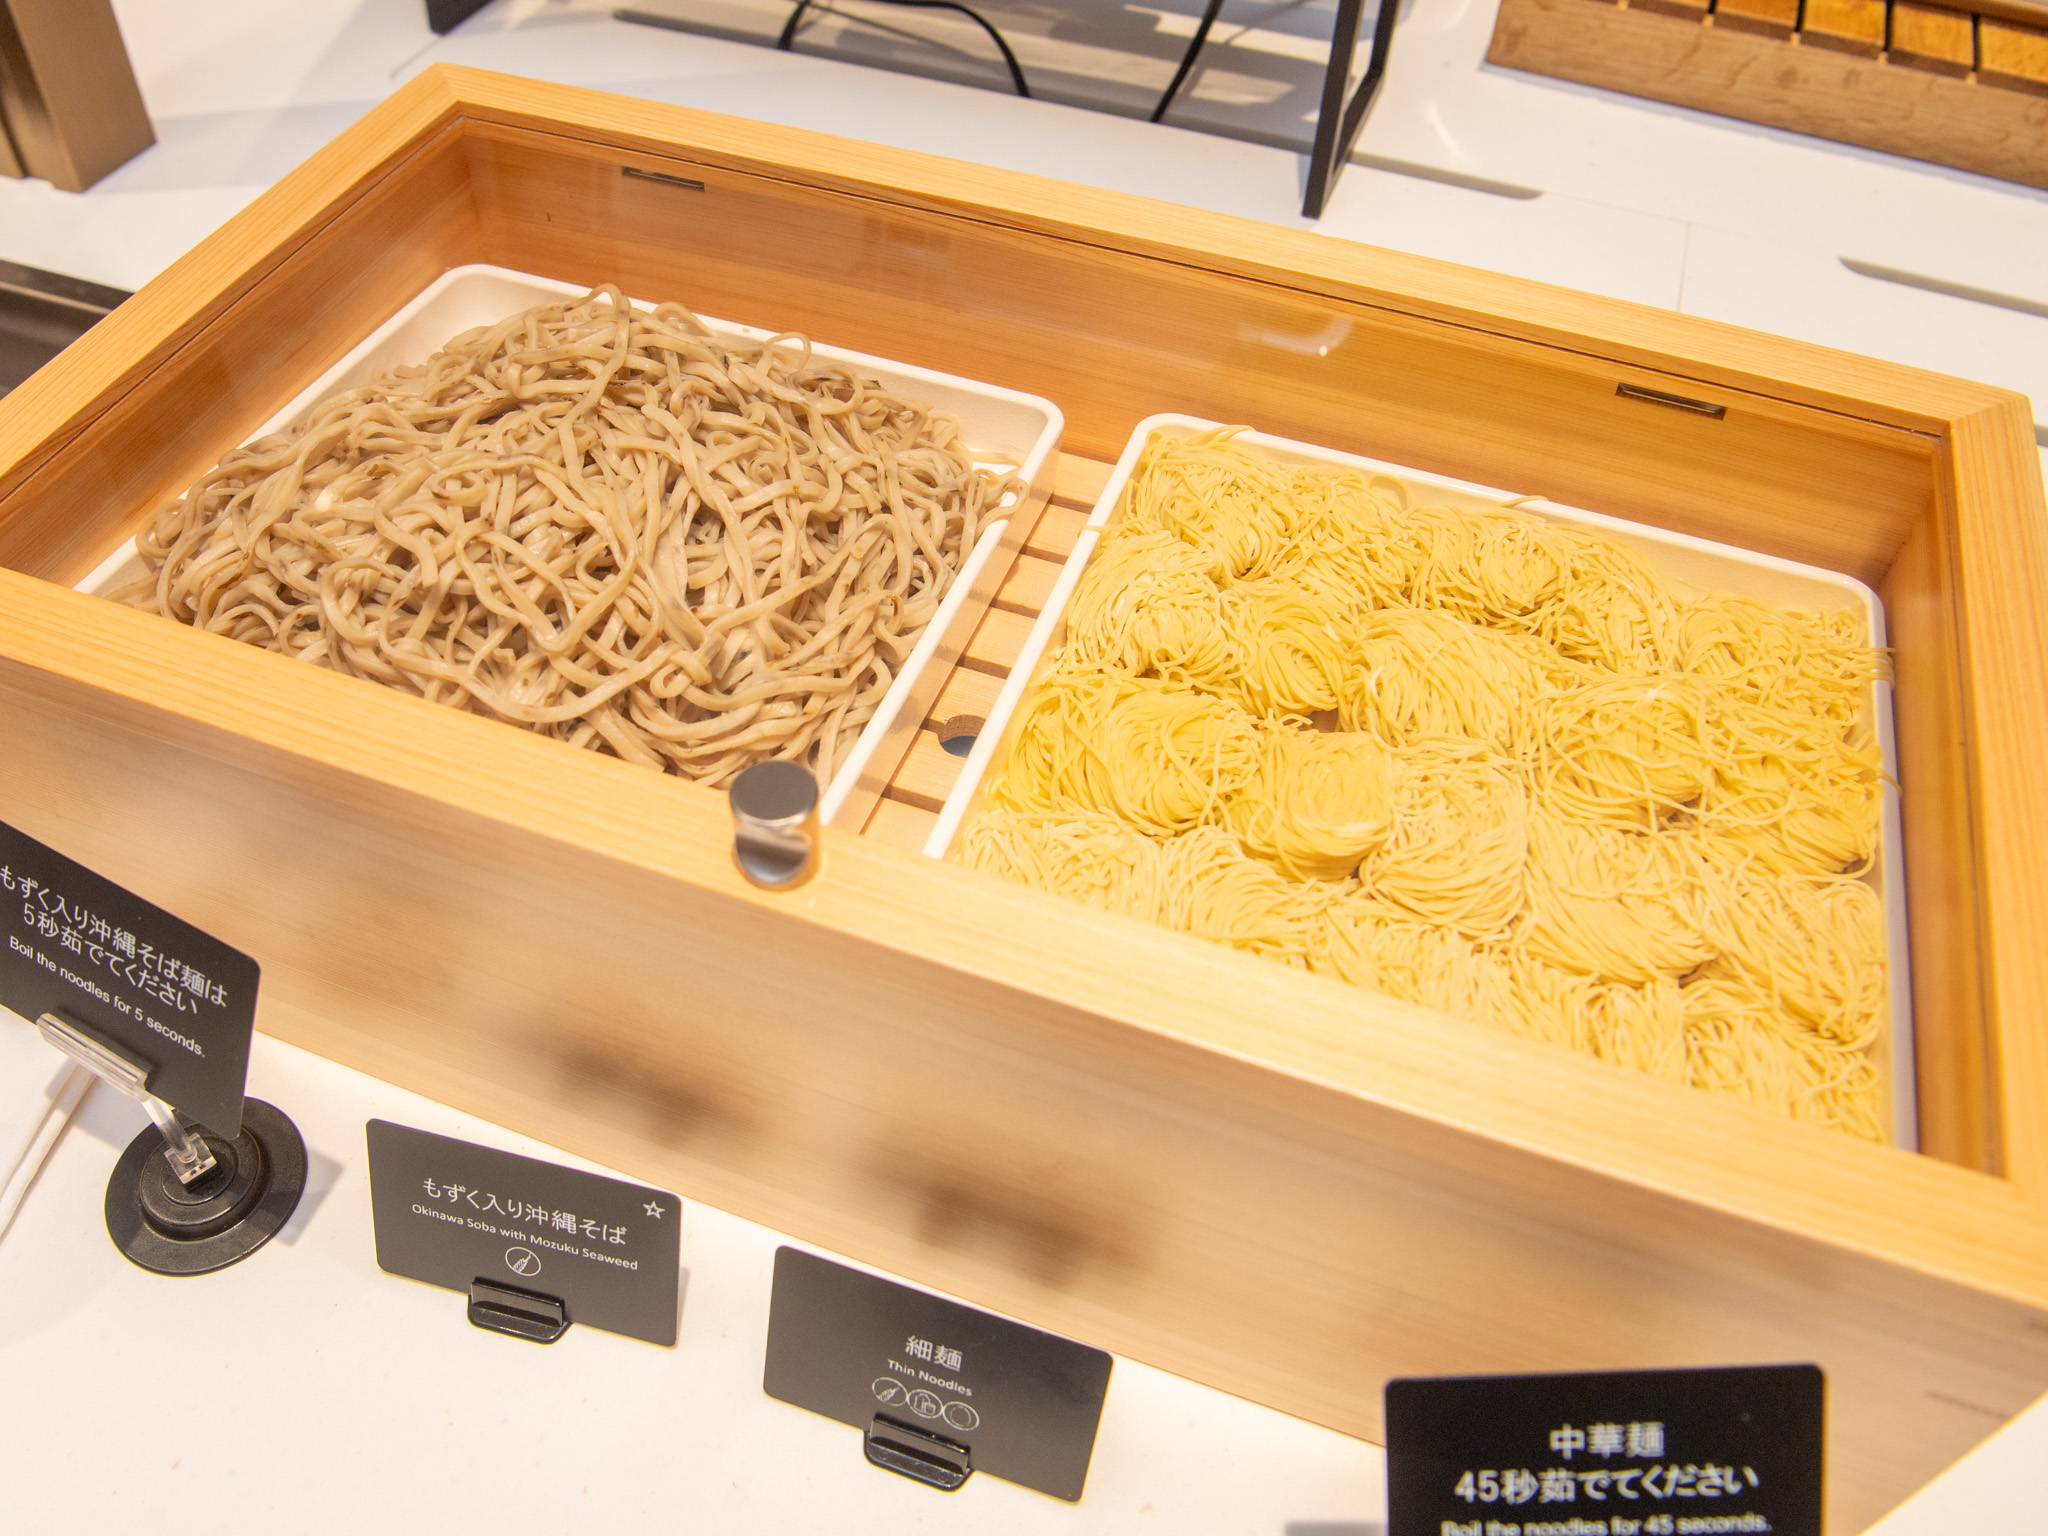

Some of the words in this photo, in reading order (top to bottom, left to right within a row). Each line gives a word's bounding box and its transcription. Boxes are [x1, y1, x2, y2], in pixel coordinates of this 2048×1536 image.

[0, 865, 228, 1008] もずく入り沖縄そば麺は
[23, 903, 198, 1014] 5秒茹でてください
[9, 935, 34, 959] Boil
[37, 951, 57, 972] the
[60, 967, 110, 1003] noodles
[114, 995, 131, 1015] for
[135, 1008, 144, 1022] 5
[147, 1016, 206, 1057] seconds.
[412, 1203, 464, 1226] Okinawa
[467, 1217, 497, 1234] Soba
[500, 1227, 527, 1242] with
[530, 1233, 579, 1256] Mozuku
[582, 1247, 638, 1271] Seaweed
[422, 1177, 627, 1246] もずく入り沖縄そば
[887, 1359, 916, 1377] Thin
[918, 1370, 973, 1397] Noodles
[905, 1335, 963, 1372] 細麺
[1549, 1422, 1665, 1460] 中華麺
[1454, 1463, 1760, 1505] 45秒茹でてください
[1610, 1514, 1642, 1536] for
[1643, 1513, 1675, 1536] 45
